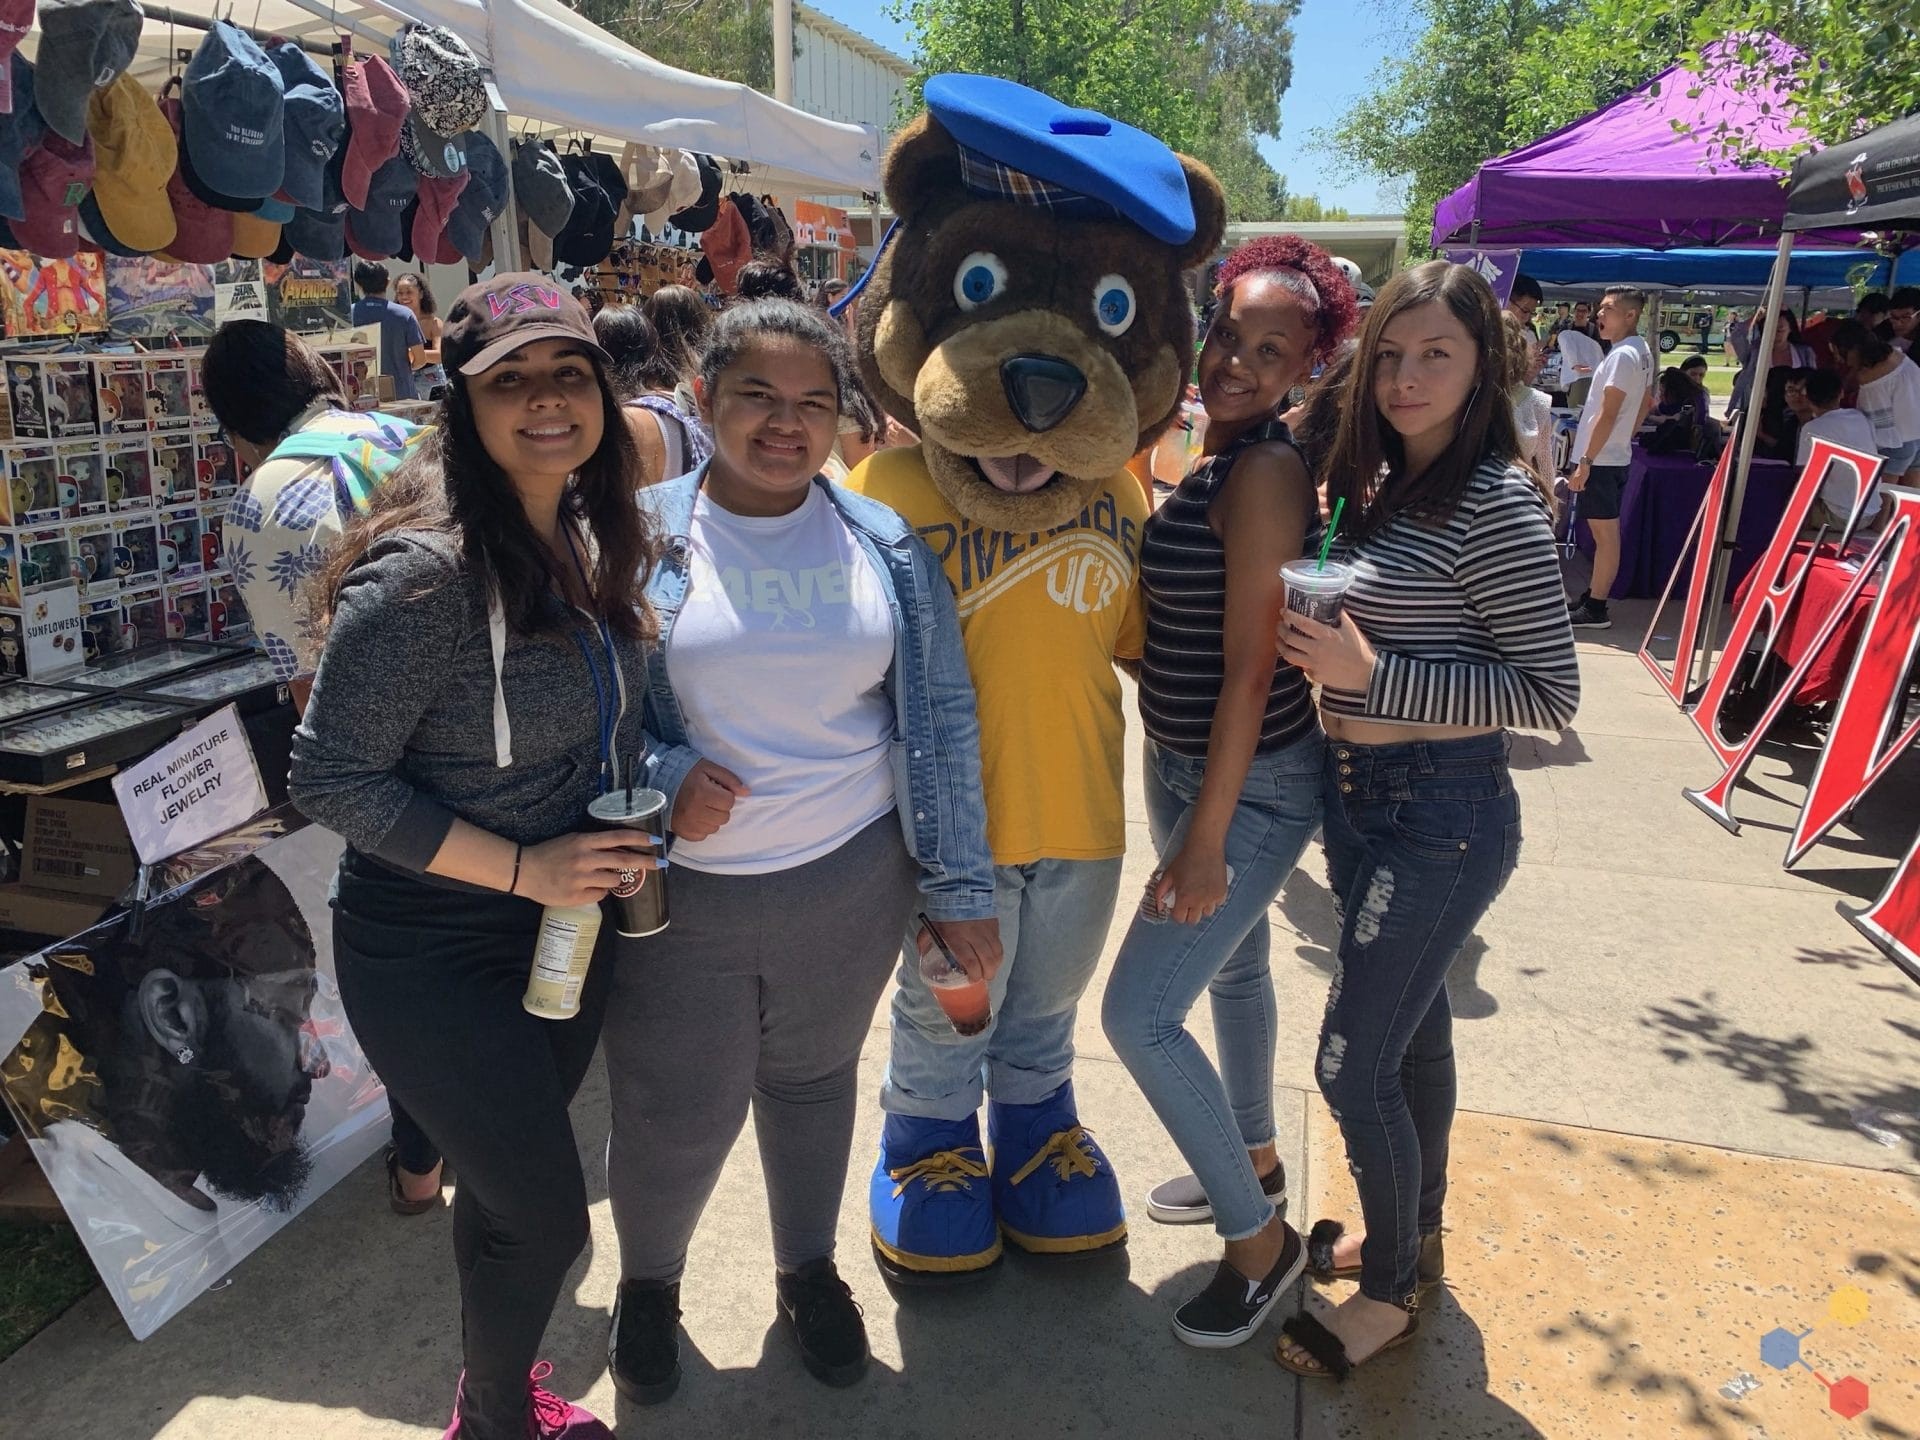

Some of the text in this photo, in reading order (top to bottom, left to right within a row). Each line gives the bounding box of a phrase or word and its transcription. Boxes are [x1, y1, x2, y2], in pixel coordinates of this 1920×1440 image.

[1046, 552, 1120, 614] UCR
[27, 616, 80, 639] SUNFLOWERS
[133, 729, 230, 798] REAL MINIATURE
[161, 758, 215, 800] FLOWER
[160, 773, 223, 825] JEWELRY
